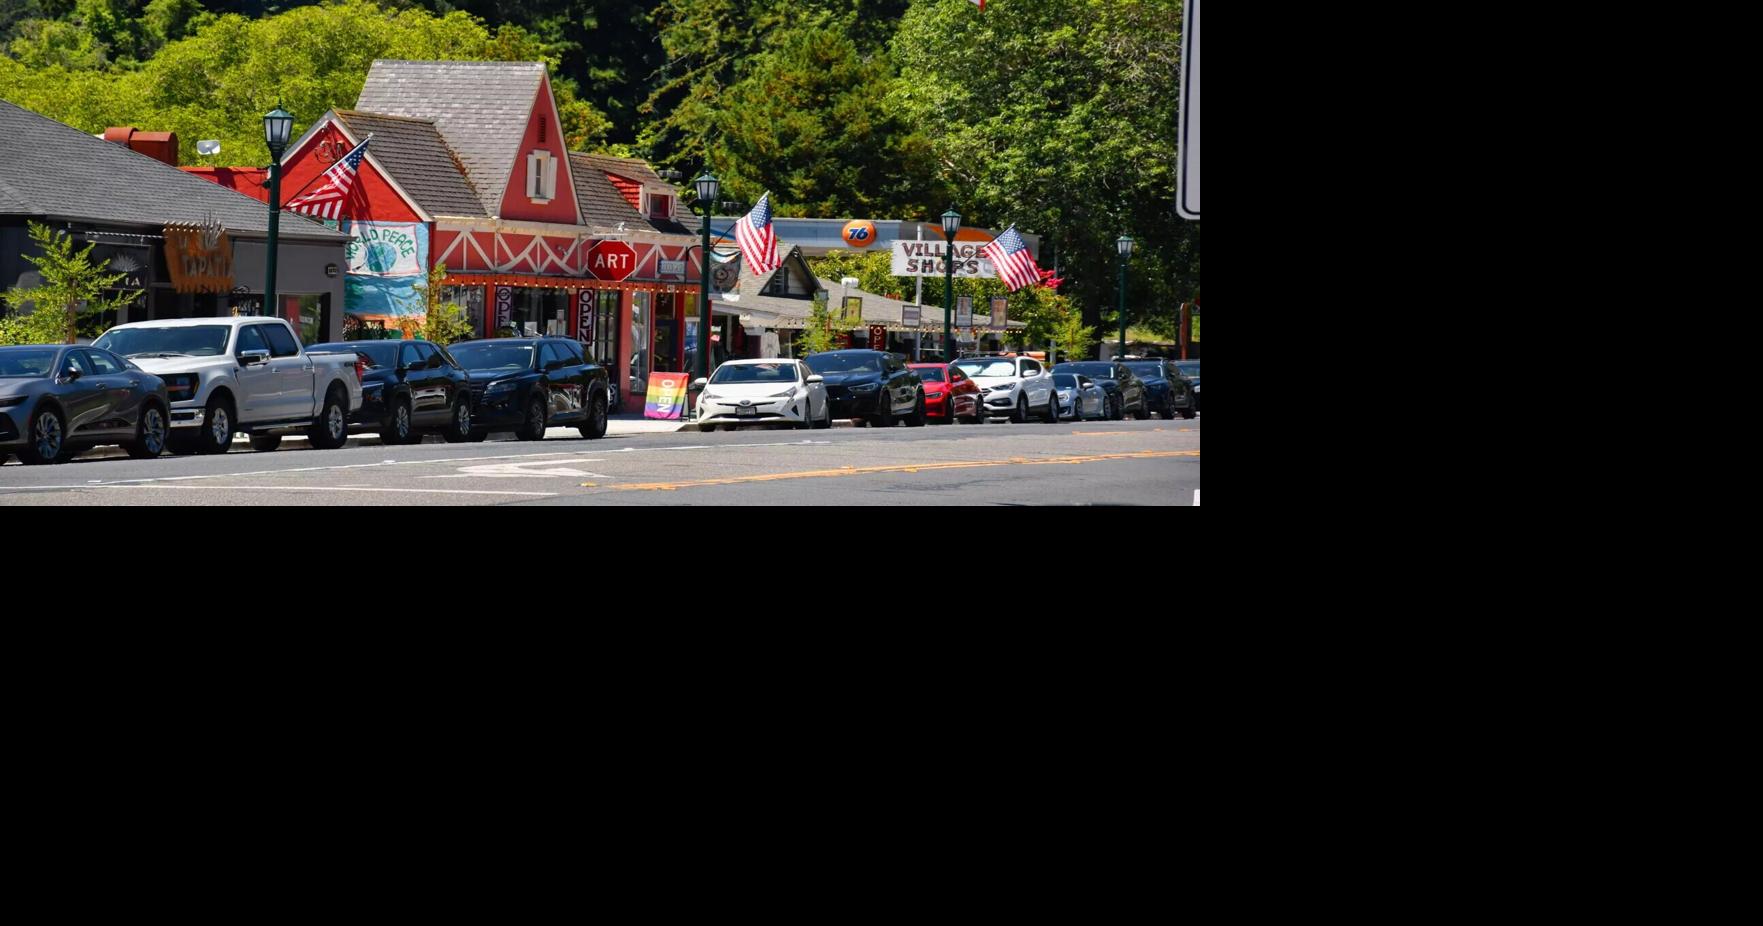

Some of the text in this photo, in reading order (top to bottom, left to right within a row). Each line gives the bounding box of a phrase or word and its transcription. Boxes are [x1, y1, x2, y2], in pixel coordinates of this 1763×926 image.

[382, 229, 415, 258] PEACE
[849, 228, 869, 240] 76
[594, 254, 629, 269] ART
[906, 259, 979, 275] SHOPS
[497, 288, 510, 328] OPE
[579, 290, 592, 346] OPEN
